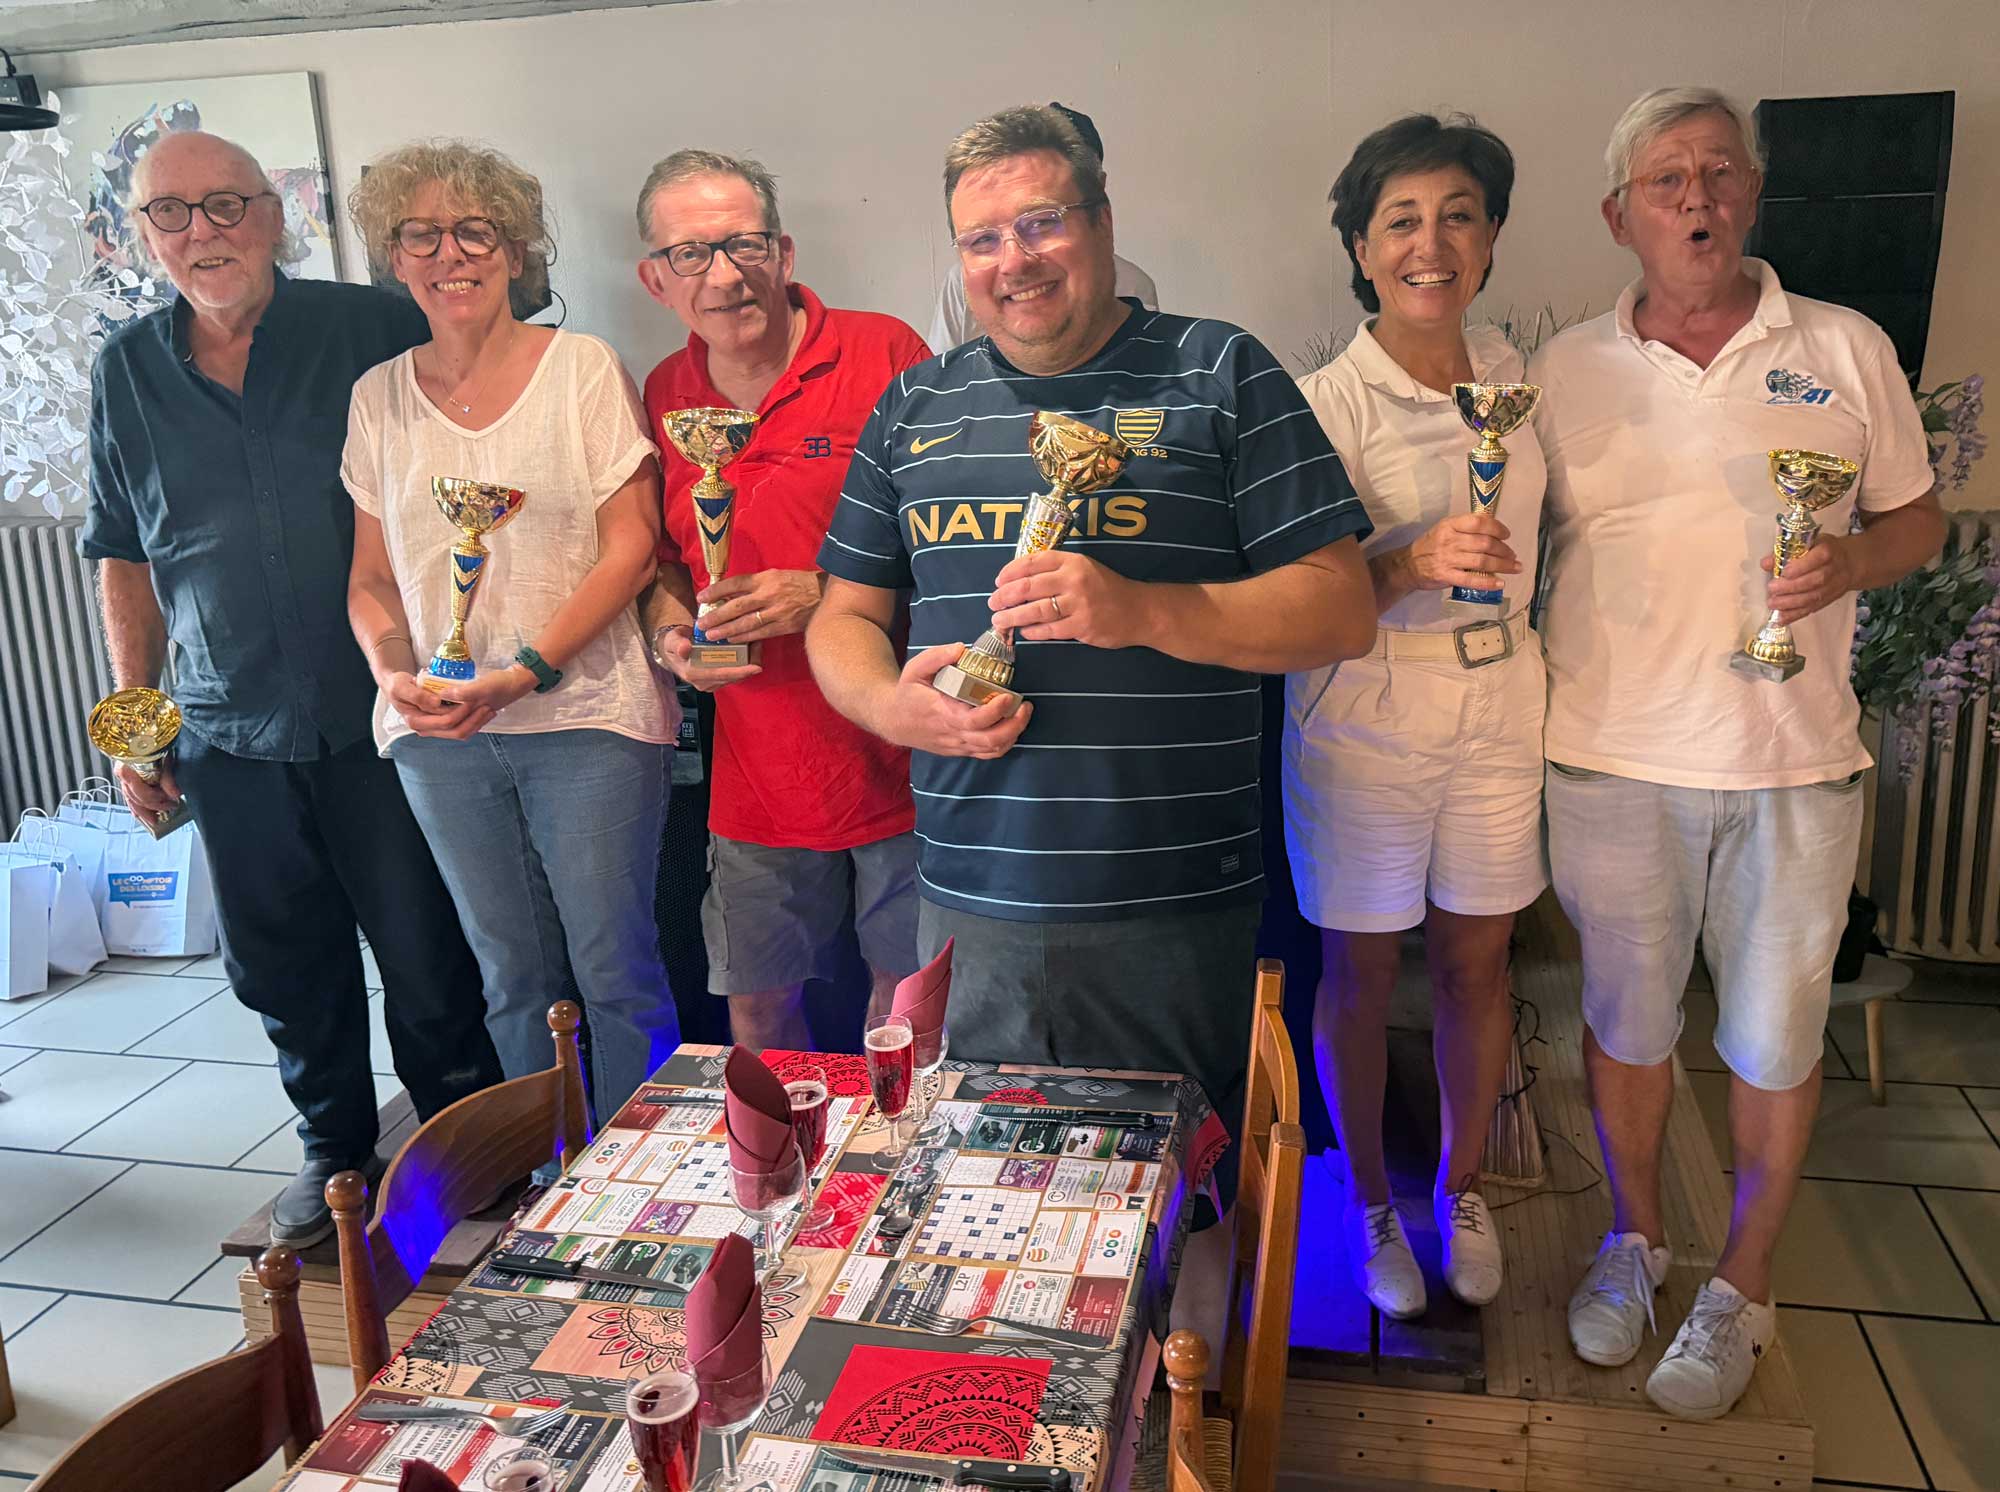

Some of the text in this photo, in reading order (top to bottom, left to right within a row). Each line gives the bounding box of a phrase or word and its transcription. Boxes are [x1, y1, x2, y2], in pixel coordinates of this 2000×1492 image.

[1802, 388, 1833, 404] 41
[1150, 448, 1168, 459] 92
[908, 496, 1147, 546] NATIS
[952, 1272, 971, 1292] L2P
[1061, 1306, 1078, 1330] SSAC
[565, 1423, 592, 1453] Leonidas
